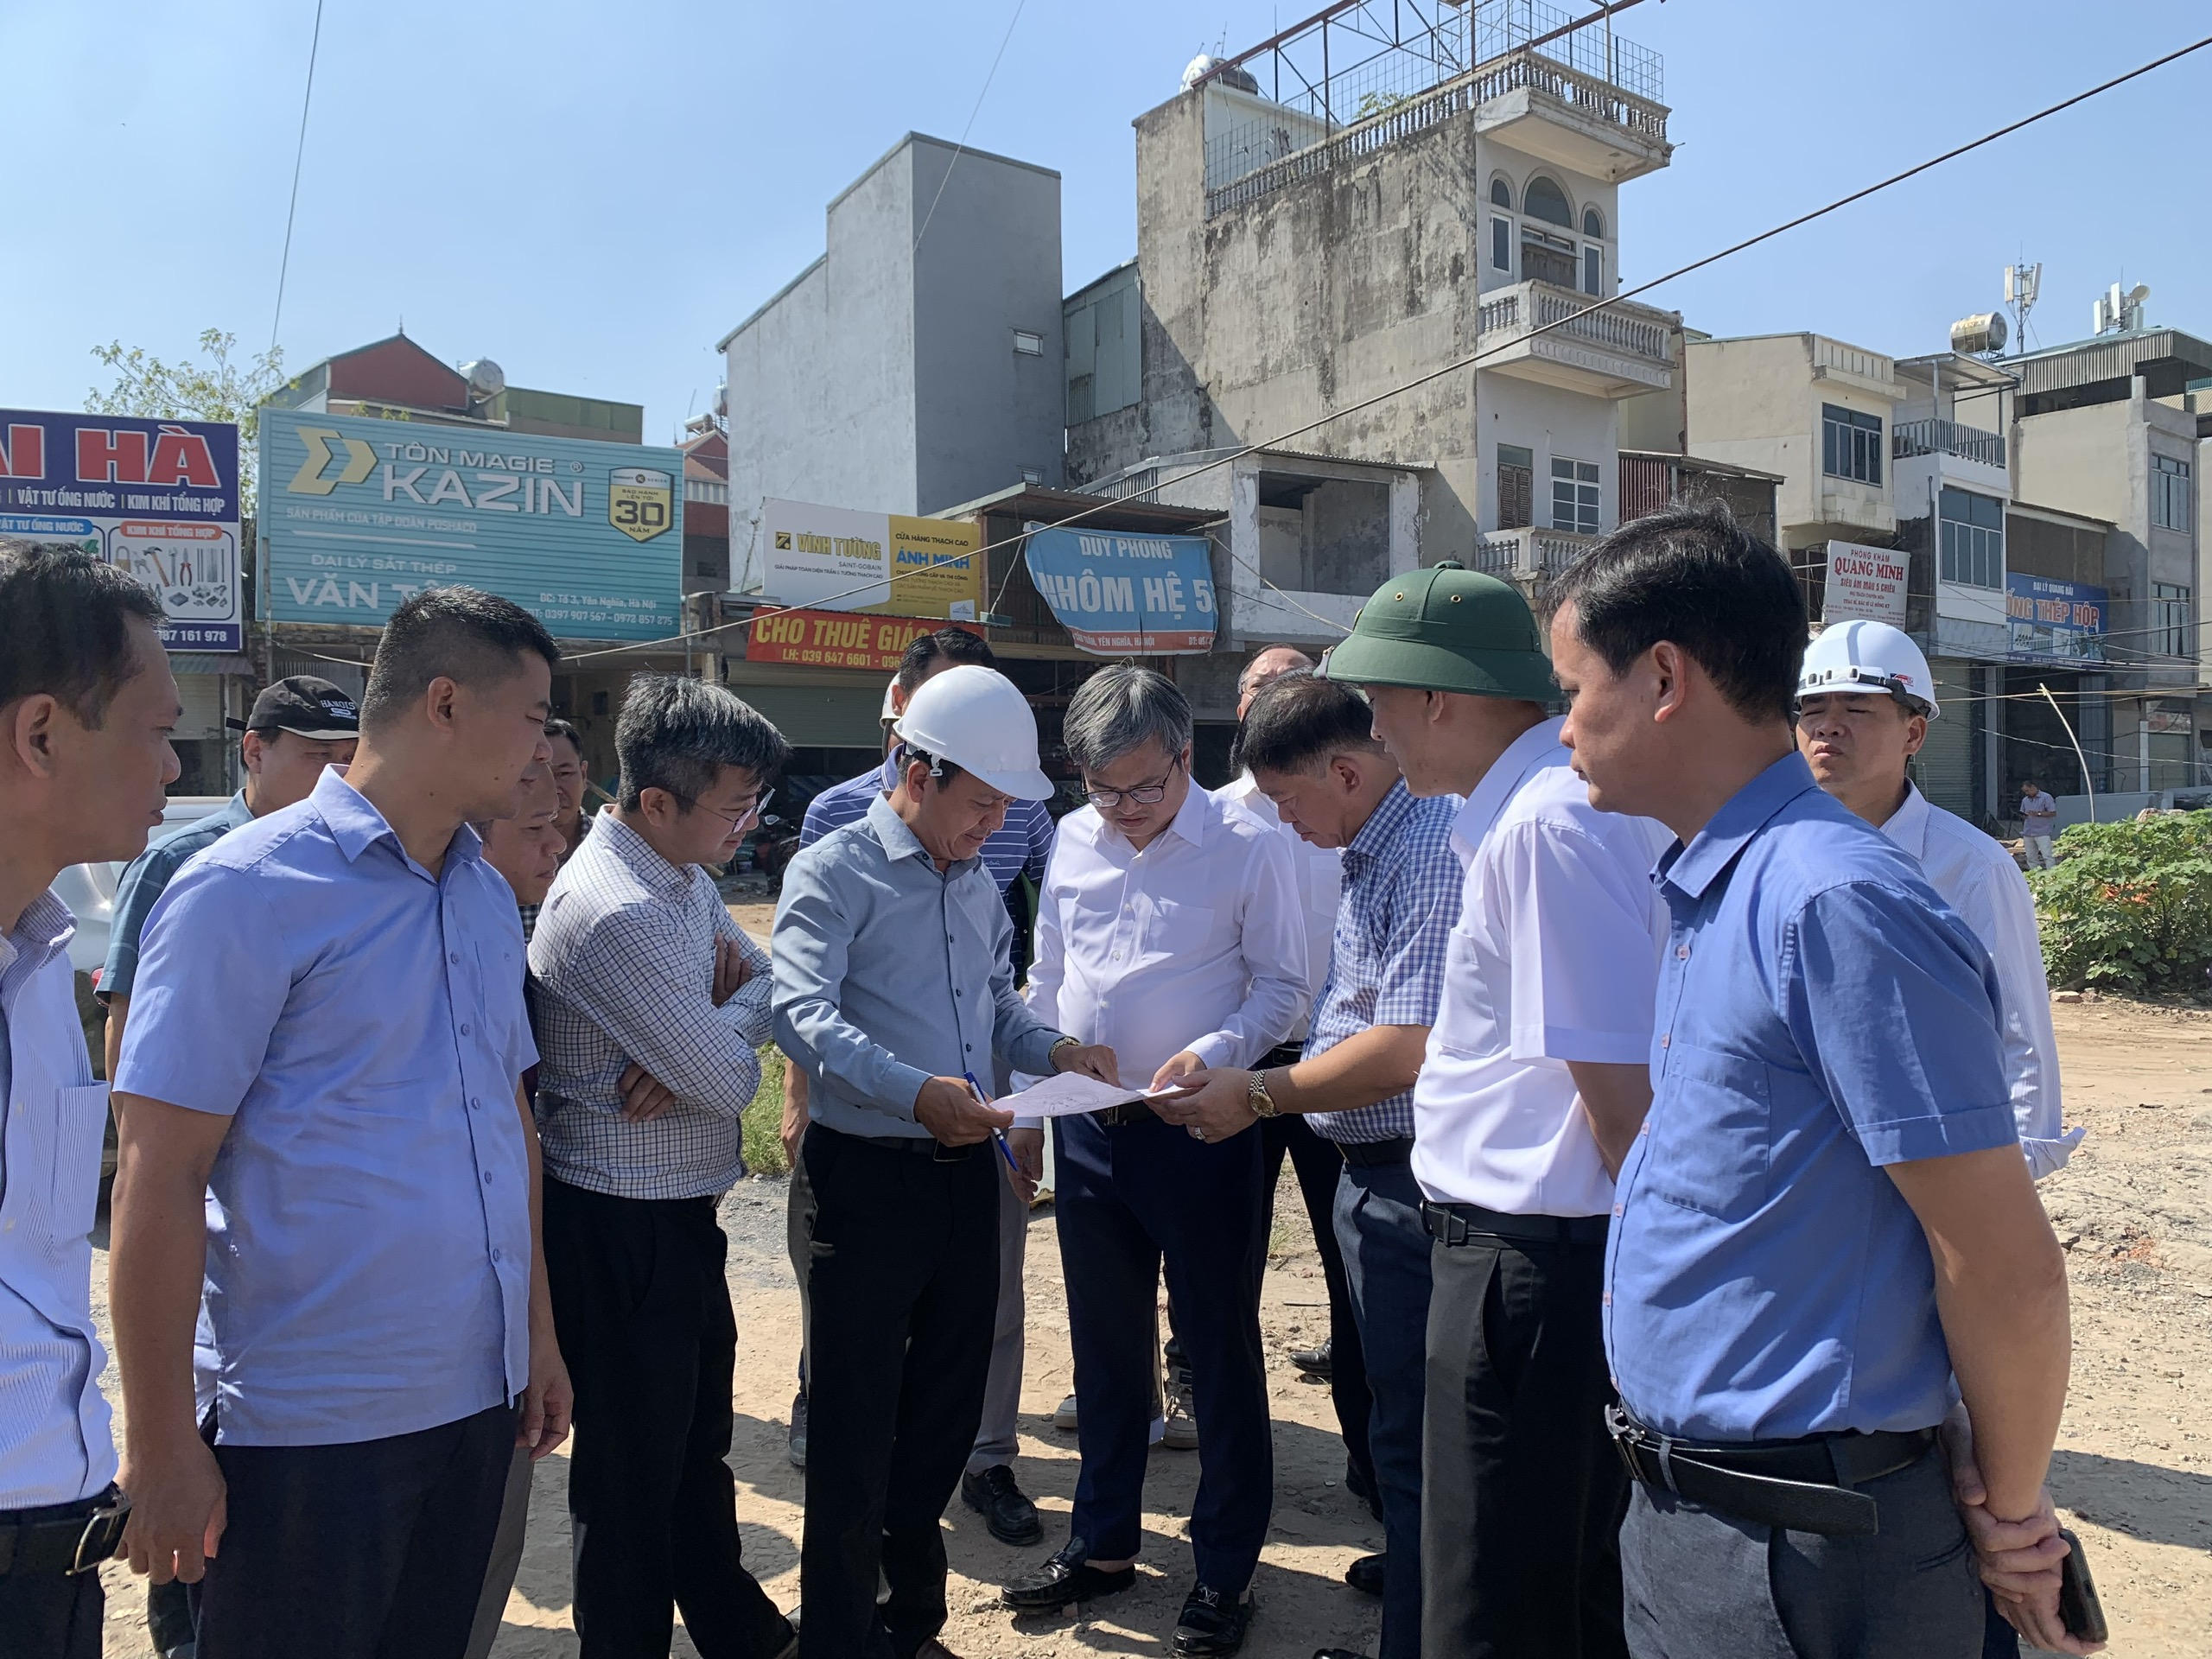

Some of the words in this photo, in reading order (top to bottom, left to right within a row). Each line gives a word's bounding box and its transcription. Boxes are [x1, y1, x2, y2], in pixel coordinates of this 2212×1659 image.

[75, 424, 222, 489] HÀ
[385, 442, 449, 465] TÔN
[460, 450, 555, 474] MAGIE
[17, 486, 40, 509] VẬT
[41, 489, 57, 506] TƯ
[57, 485, 82, 507] ỐNG
[84, 490, 116, 509] NƯỚC
[127, 493, 149, 511] KIM
[151, 493, 171, 512] KHÍ
[172, 491, 201, 513] TỔNG
[202, 497, 226, 517] HỢP
[384, 464, 582, 518] KAZIN
[615, 499, 664, 527] 30
[126, 524, 147, 536] KIM
[629, 525, 650, 534] NĂM
[797, 531, 832, 556] VĨNH
[834, 536, 881, 562] TƯỜNG
[1079, 536, 1111, 557] DUY
[1117, 538, 1173, 560] PHONG
[1851, 548, 1872, 561] PHÒNG
[347, 554, 367, 569] LÝ
[410, 561, 457, 575] THÉP
[838, 561, 882, 571] SAINT-GOBAIN
[1834, 556, 1873, 576] QUANG
[1876, 563, 1904, 582] MINH
[286, 571, 378, 609] VĂN
[1037, 568, 1135, 613] NHÔM
[1142, 570, 1186, 620] HỆ
[628, 598, 640, 608] Hà
[2036, 596, 2070, 624] THÉP
[2072, 601, 2100, 632] HỘP
[544, 609, 569, 620] 0397
[570, 610, 588, 621] 907
[589, 611, 607, 622] 567
[613, 612, 637, 624] 0972
[638, 613, 655, 625] 857
[657, 615, 673, 626] 275
[180, 630, 201, 642] 161
[205, 630, 227, 643] 978
[755, 616, 806, 645] CHO
[813, 618, 872, 650] THUÊ
[1097, 635, 1110, 647] YÊN
[782, 648, 798, 662] LH:
[802, 649, 822, 663] 039
[823, 651, 843, 664] 647
[846, 652, 871, 667] 6601
